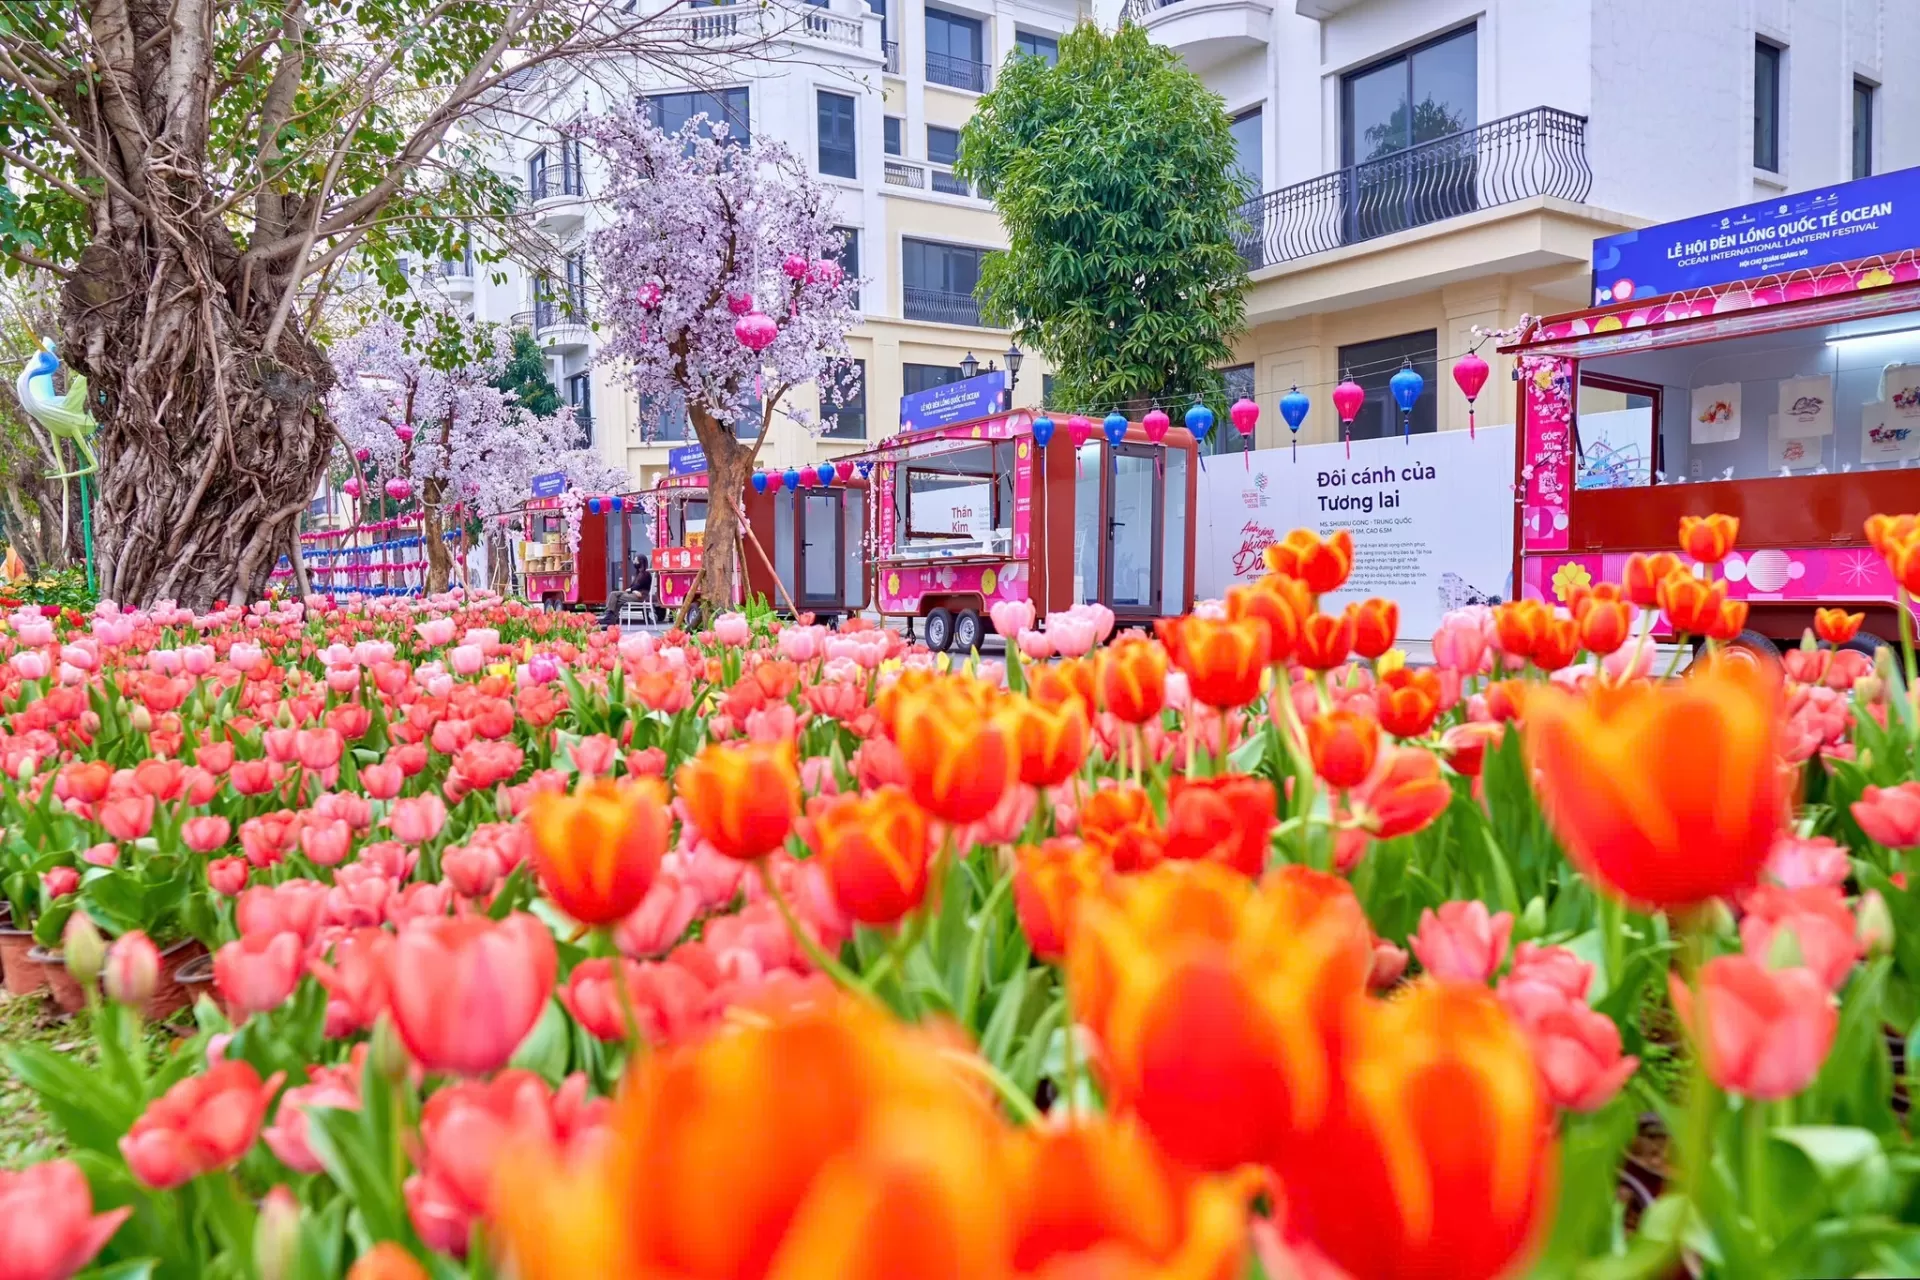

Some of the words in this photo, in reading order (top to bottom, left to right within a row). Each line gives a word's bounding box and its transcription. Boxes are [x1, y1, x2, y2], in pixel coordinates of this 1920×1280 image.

[1667, 242, 1683, 259] LỄ
[1685, 239, 1707, 256] HỘI
[1710, 234, 1736, 251] ĐÈN
[1778, 215, 1818, 238] QUỐC
[1820, 208, 1839, 228] TẾ
[1840, 201, 1892, 224] OCEAN
[1677, 255, 1709, 268] OCEAN
[1711, 240, 1784, 261] INTERNATIONAL
[1785, 231, 1830, 247] LANTERN
[1832, 221, 1879, 237] FESTIVAL
[1316, 468, 1346, 487] Đôi
[1351, 465, 1396, 485] cánh
[1401, 461, 1436, 481] của
[1317, 494, 1373, 513] Tương
[1379, 489, 1400, 508] lai
[952, 520, 969, 533] Kim
[1394, 517, 1412, 525] QUỐC
